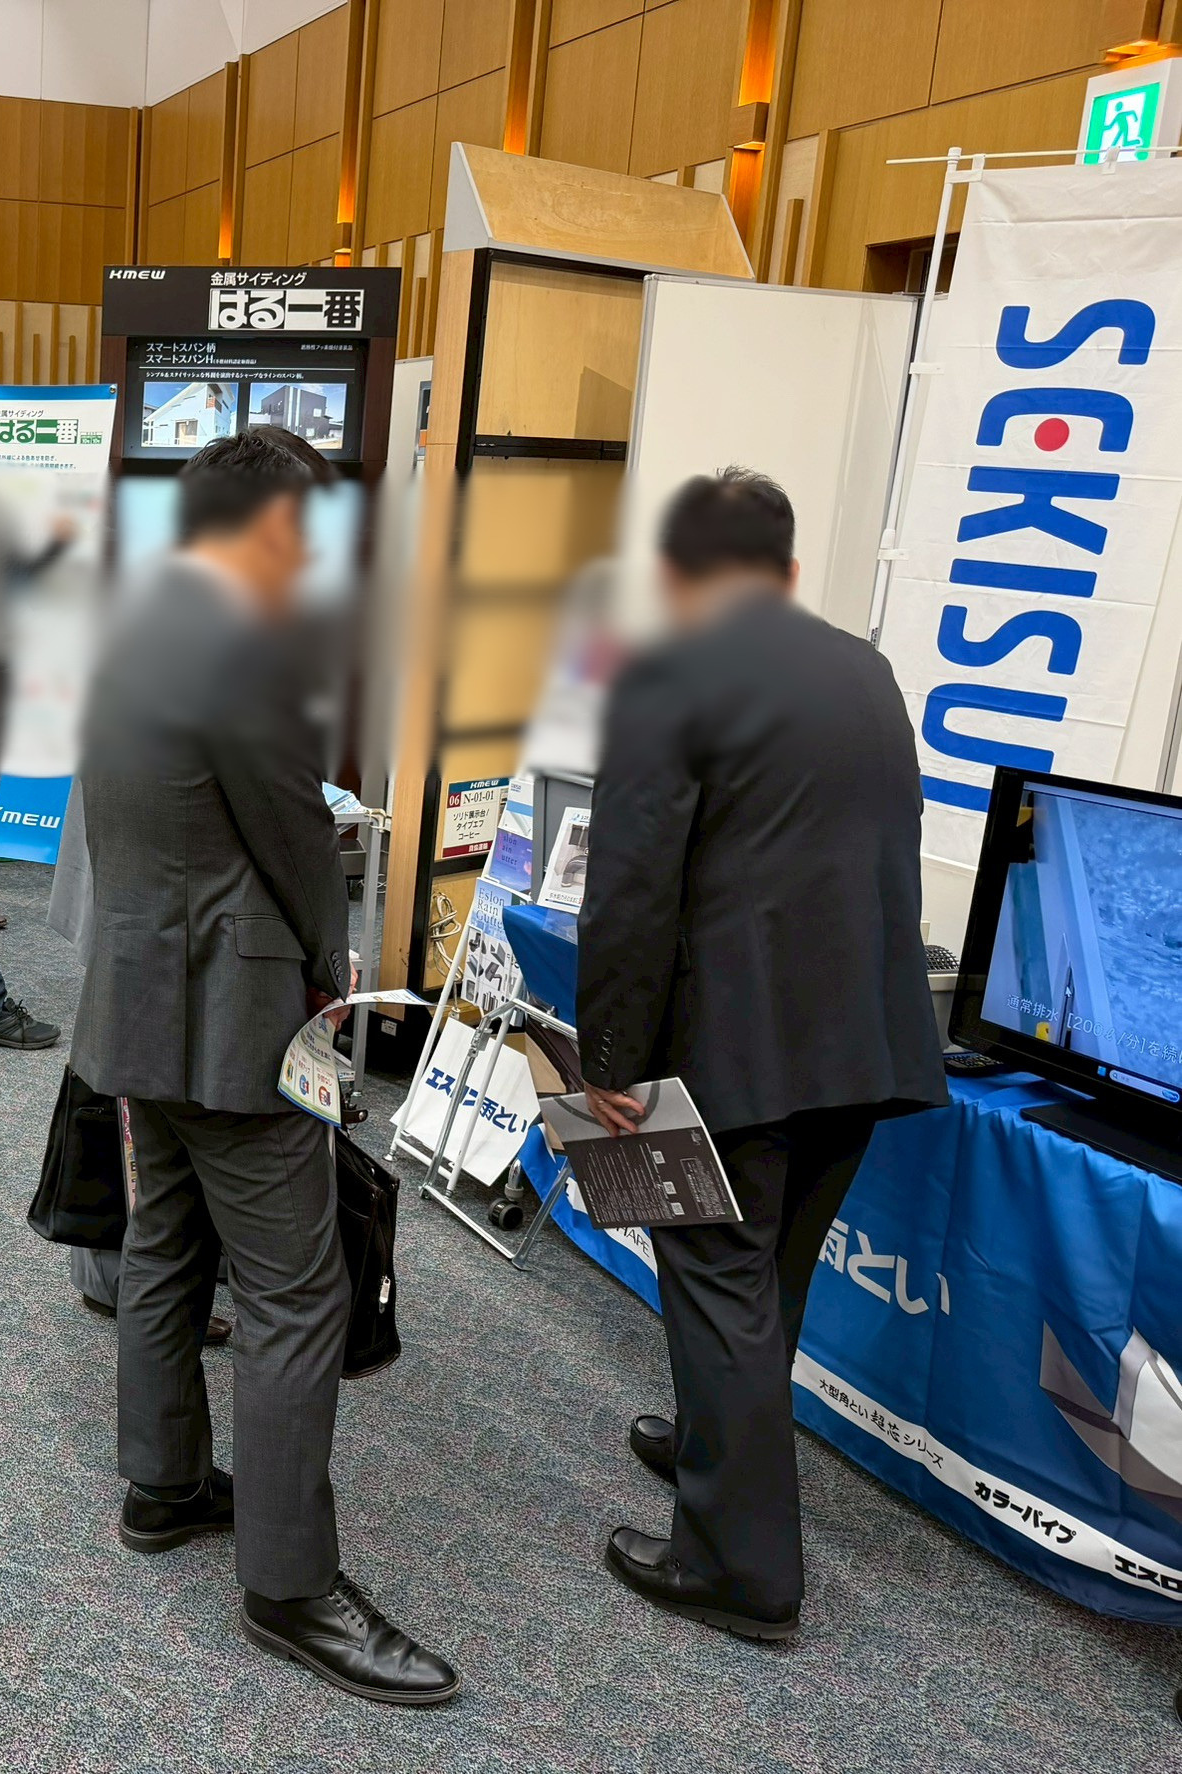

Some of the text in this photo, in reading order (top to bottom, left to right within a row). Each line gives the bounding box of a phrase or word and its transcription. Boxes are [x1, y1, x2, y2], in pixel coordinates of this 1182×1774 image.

[109, 269, 166, 280] KMEW
[210, 272, 307, 286] 金属サイディング
[210, 289, 364, 329] はる一番
[146, 342, 216, 353] スマートスパン柄
[145, 354, 213, 364] スマートスパンH
[469, 779, 500, 789] KMEW
[449, 790, 495, 806] 06 N-01-01
[458, 831, 481, 840] コーヒー
[478, 887, 504, 906] Eslon
[476, 900, 499, 916] Rain
[1006, 994, 1059, 1022] 通常排水
[616, 1226, 650, 1258] HAPE
[974, 1480, 1077, 1544] カラーパイプ
